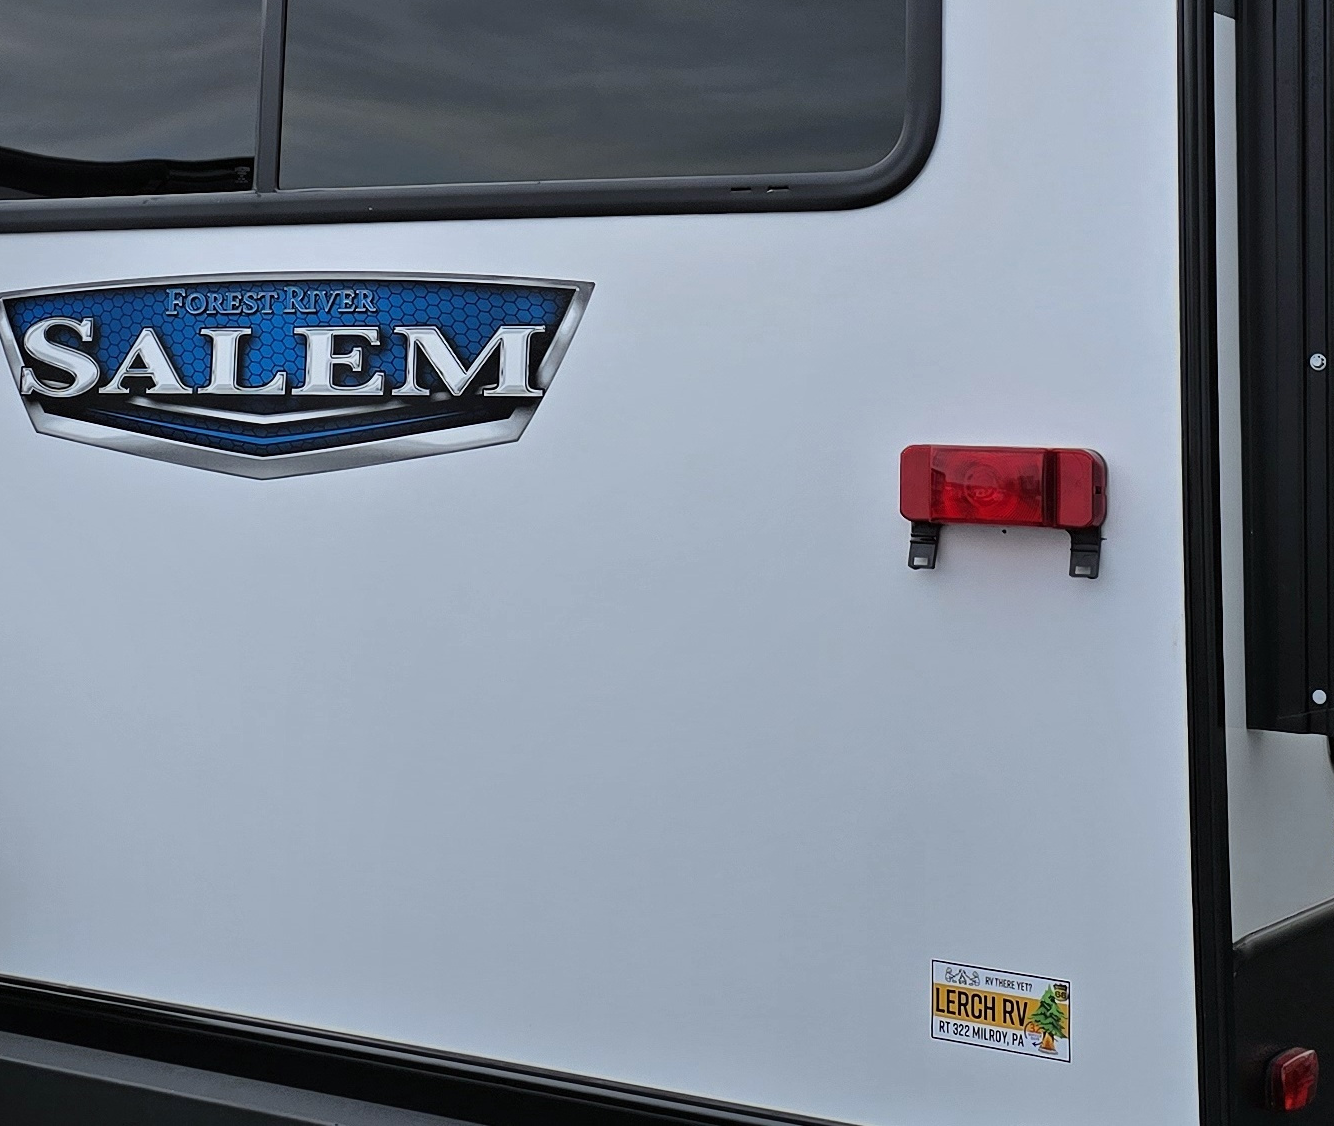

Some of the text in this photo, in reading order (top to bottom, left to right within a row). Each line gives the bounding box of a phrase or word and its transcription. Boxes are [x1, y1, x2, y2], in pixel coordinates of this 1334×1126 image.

[165, 286, 378, 315] FOREST RIVER
[20, 317, 546, 398] SALEM
[985, 976, 1033, 993] RV THERE YET?
[935, 987, 1028, 1027] LERCH RV
[939, 1020, 951, 1034] RT
[952, 1023, 970, 1038] 322
[972, 1027, 1010, 1047] MILROY,
[1012, 1033, 1025, 1047] PA
